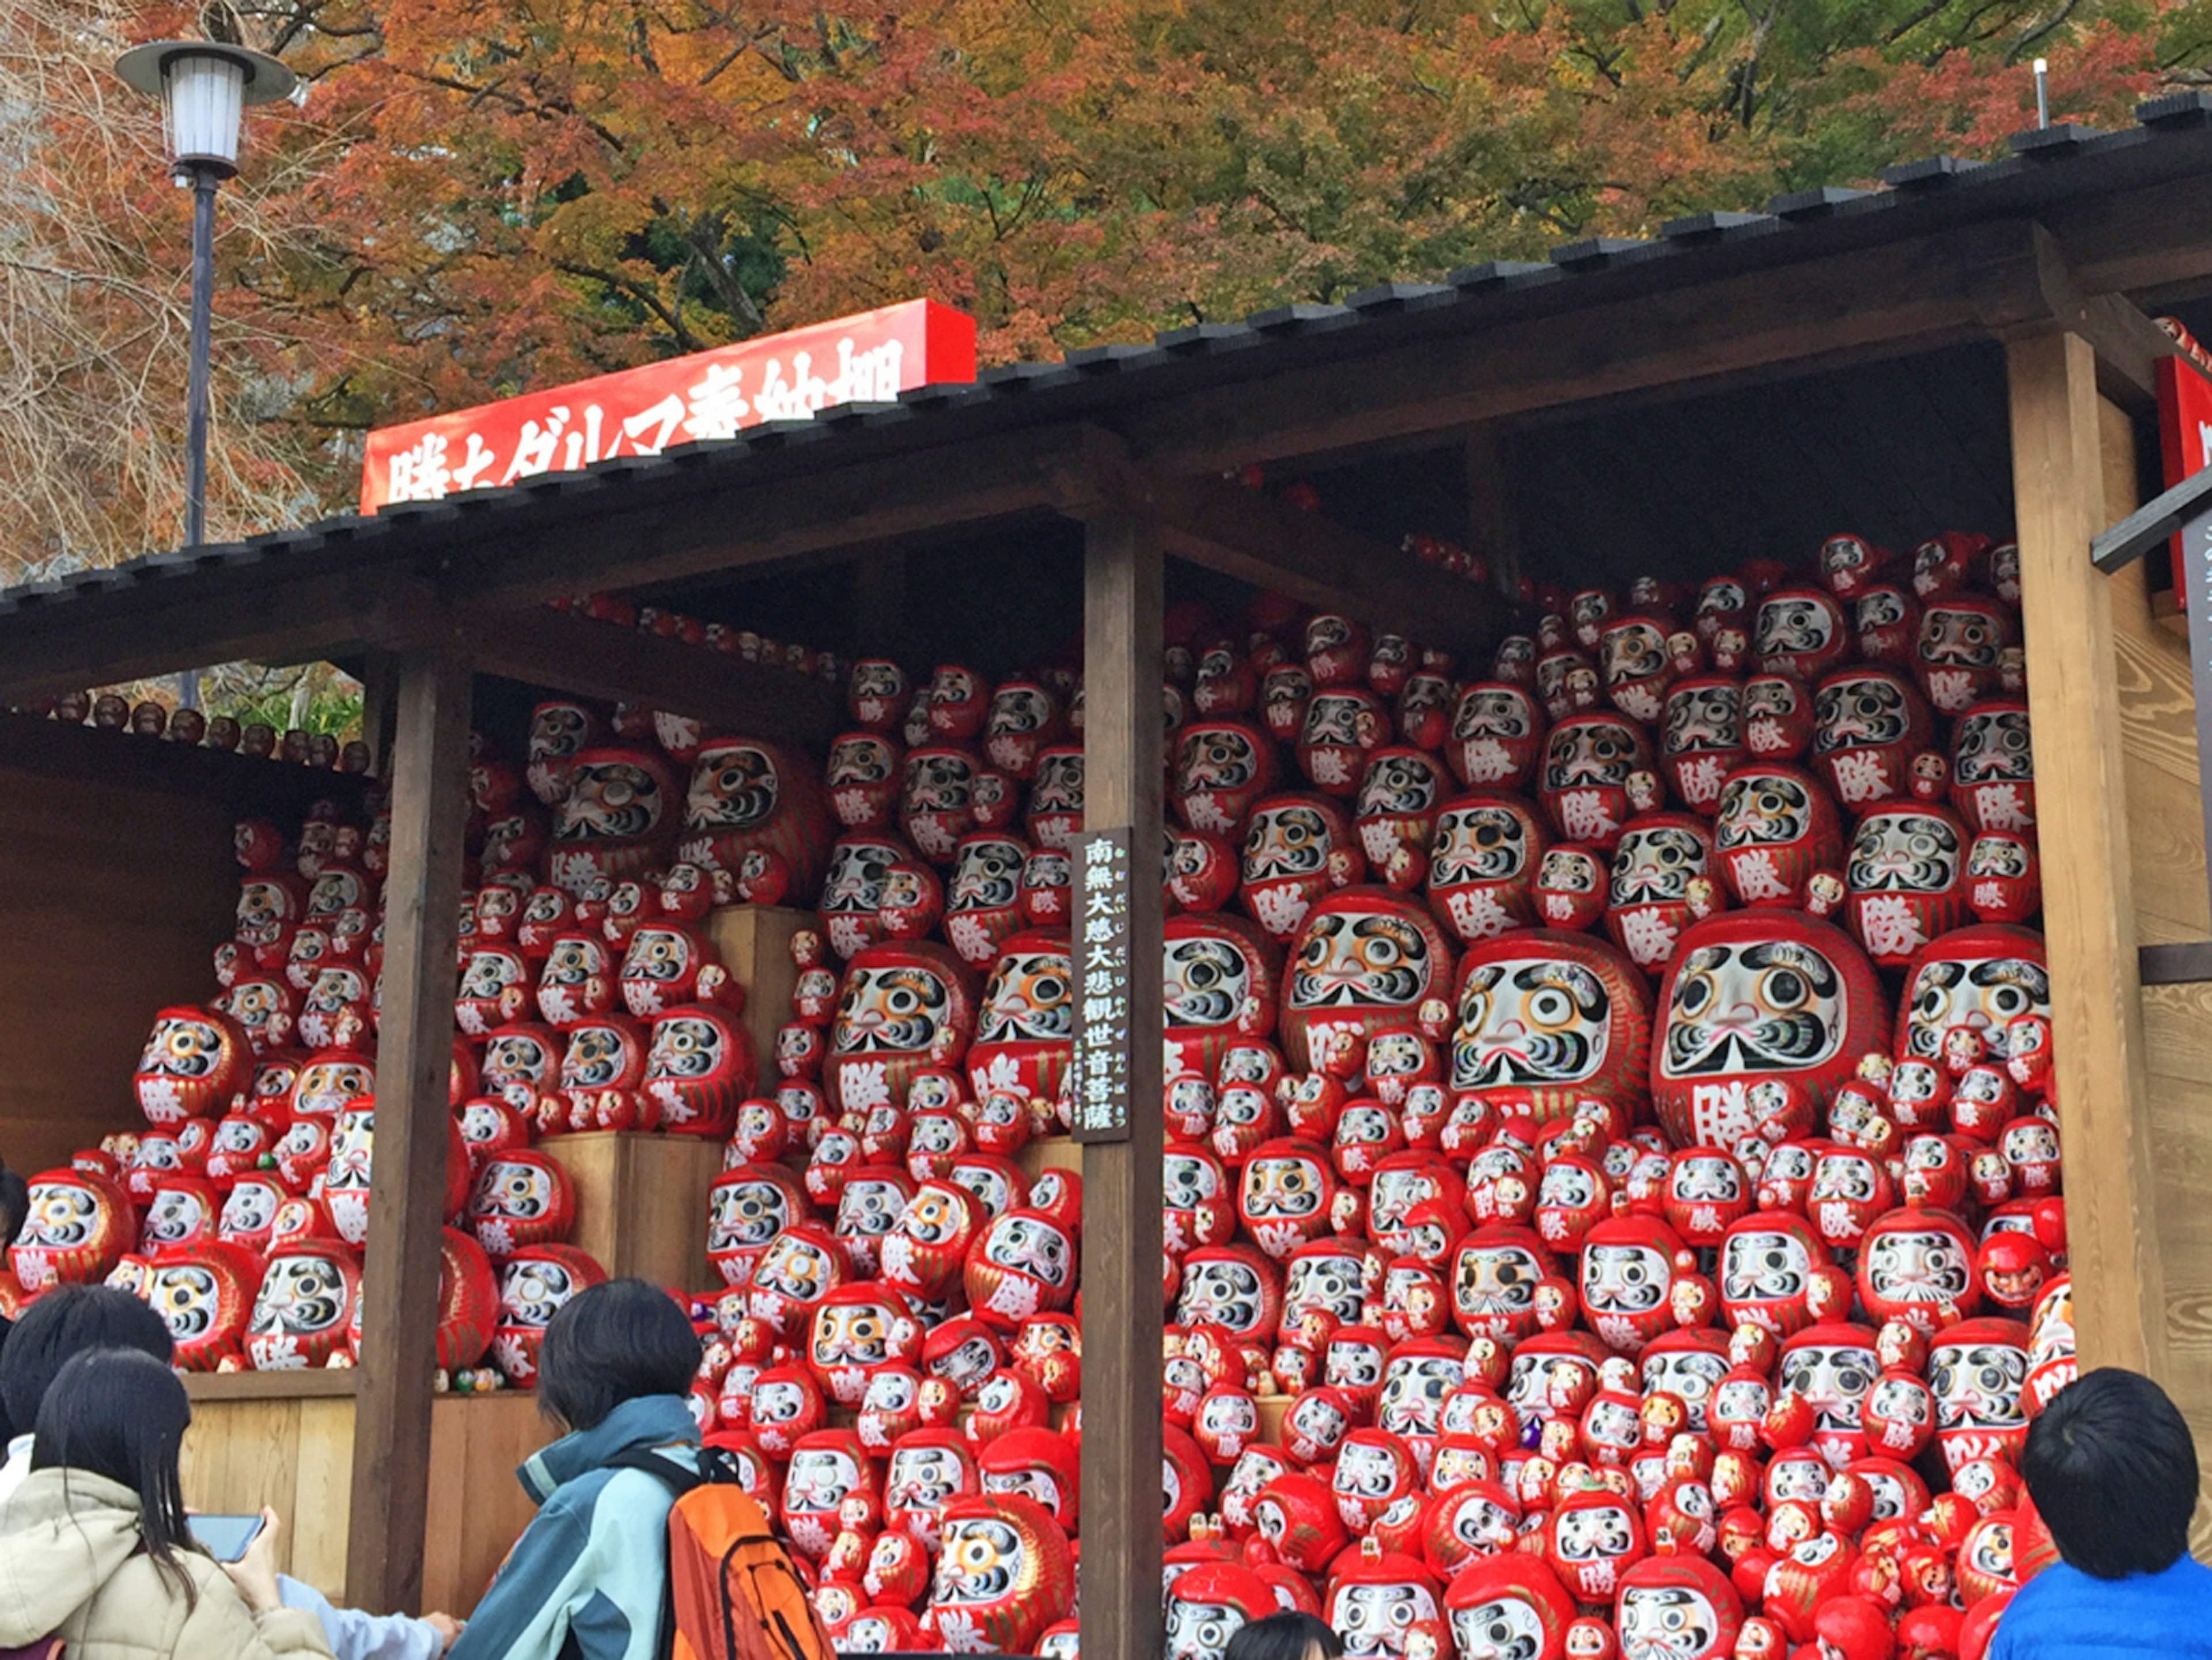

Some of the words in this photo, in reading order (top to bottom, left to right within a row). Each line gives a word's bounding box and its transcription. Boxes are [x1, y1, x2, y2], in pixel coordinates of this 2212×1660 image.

[1928, 671, 1976, 709] 勝
[1465, 736, 1517, 782] 勝
[1678, 756, 1727, 803] 勝
[1831, 751, 1892, 801] 勝
[836, 788, 874, 825] 勝
[1185, 793, 1235, 833] 勝
[1562, 796, 1618, 839] 勝
[1975, 784, 2033, 831] 勝
[911, 813, 956, 854] 勝
[1732, 849, 1789, 901] 勝
[1973, 880, 2006, 909] 勝
[1448, 885, 1518, 938] 勝
[1861, 896, 1927, 956] 勝
[830, 915, 869, 959] 勝
[950, 914, 996, 961] 勝
[1620, 907, 1677, 962] 勝
[539, 986, 582, 1024] 勝
[624, 981, 663, 1015] 勝
[1082, 838, 1118, 1130] 南無大慈大悲観世音菩薩
[139, 1081, 188, 1123] 勝
[840, 1061, 889, 1112] 勝
[1539, 1211, 1568, 1239] 勝
[1820, 1201, 1864, 1238] 勝
[882, 1234, 920, 1283] 勝
[986, 1273, 1039, 1320] 勝
[1884, 1419, 1915, 1450] 勝
[1578, 1559, 1618, 1594] 勝
